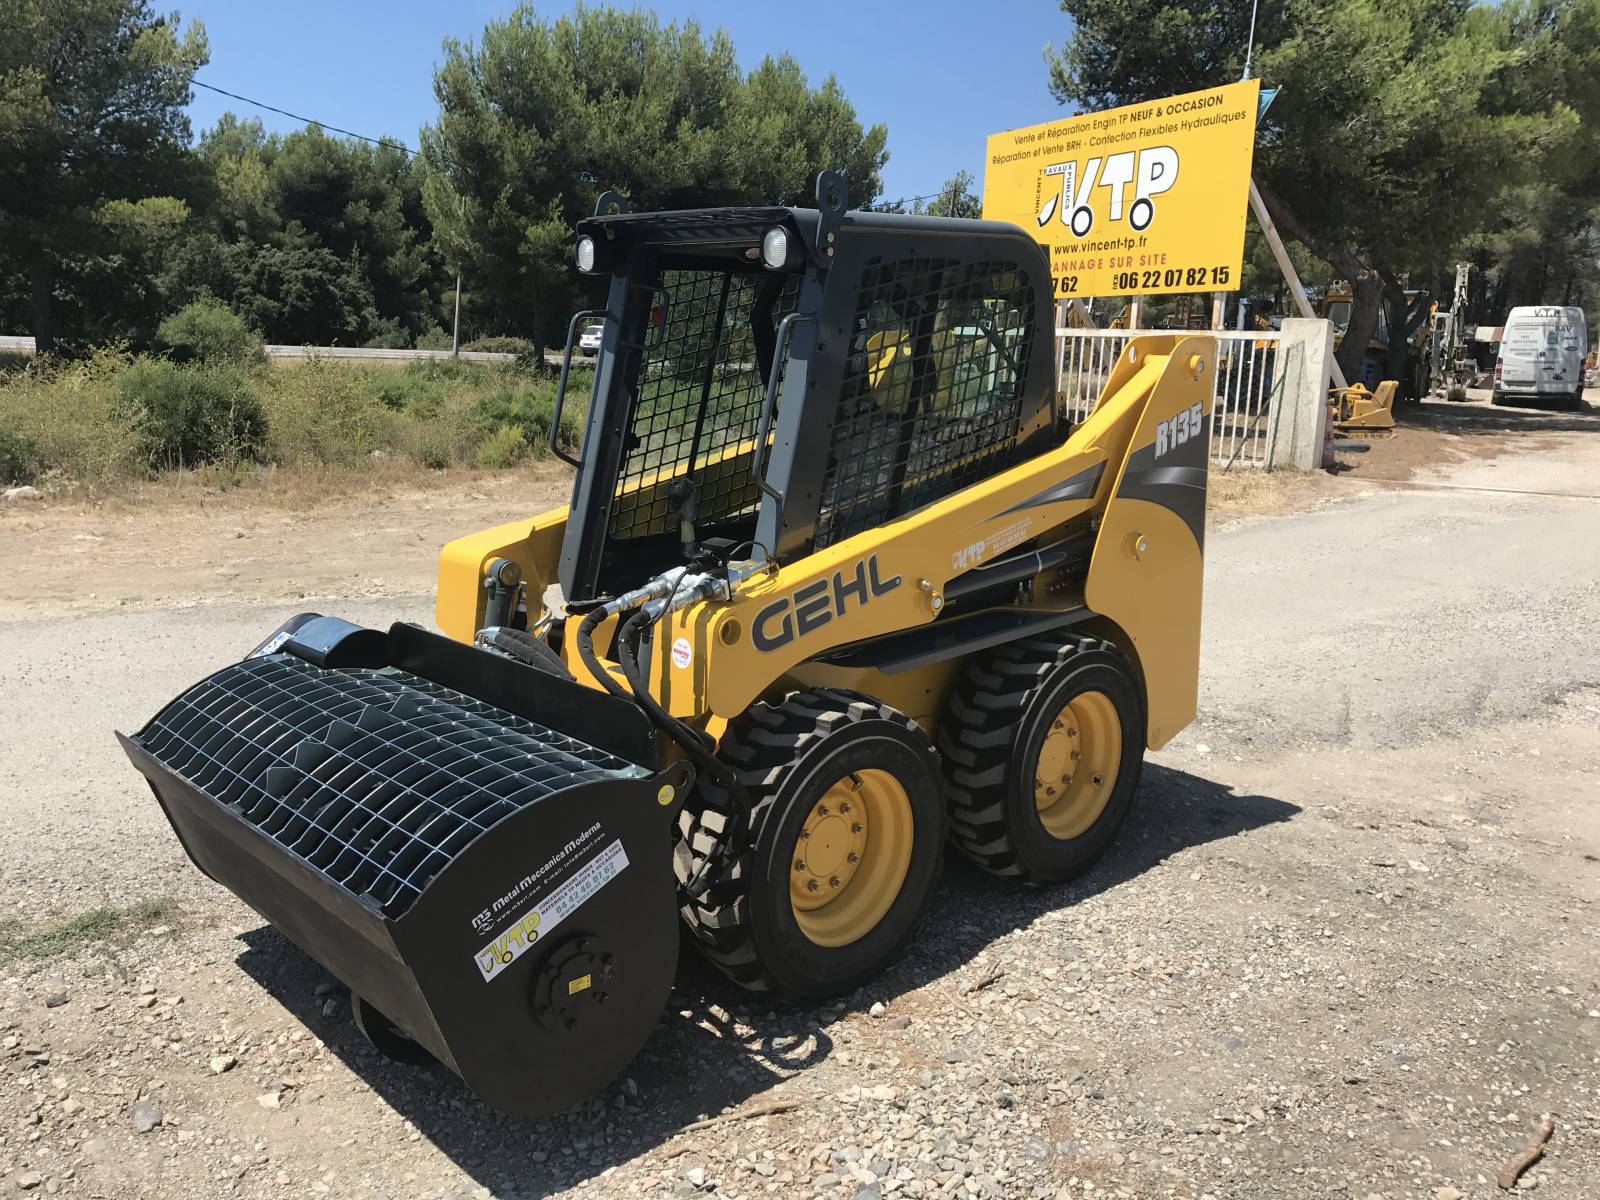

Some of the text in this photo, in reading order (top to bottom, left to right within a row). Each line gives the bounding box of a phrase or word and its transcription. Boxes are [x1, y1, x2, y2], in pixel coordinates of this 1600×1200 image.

[1014, 94, 1224, 145] Vente et Réparation Engin TP NEUF & OCCASION
[992, 150, 1031, 165] Réparation
[1033, 147, 1041, 157] et
[1042, 144, 1064, 155] Vente
[1066, 140, 1081, 151] BRH
[1089, 128, 1137, 147] Confection
[1139, 121, 1178, 137] Flexibles
[1181, 110, 1246, 132] Hydrauliques
[1039, 163, 1073, 176] TRAVAUX
[1064, 172, 1072, 210] PUBLICS
[1054, 235, 1147, 255] www.vincent-tp.fr
[1051, 253, 1167, 273] ANNAGE SUR SITE
[1052, 276, 1078, 294] 7 62
[1119, 272, 1138, 290] 06
[1142, 269, 1161, 288] 22
[1164, 269, 1183, 287] 07
[1186, 267, 1207, 286] 82
[1210, 266, 1230, 285] 15
[1155, 401, 1203, 461] R135
[751, 552, 902, 654] GEHL
[492, 885, 520, 913] Metal
